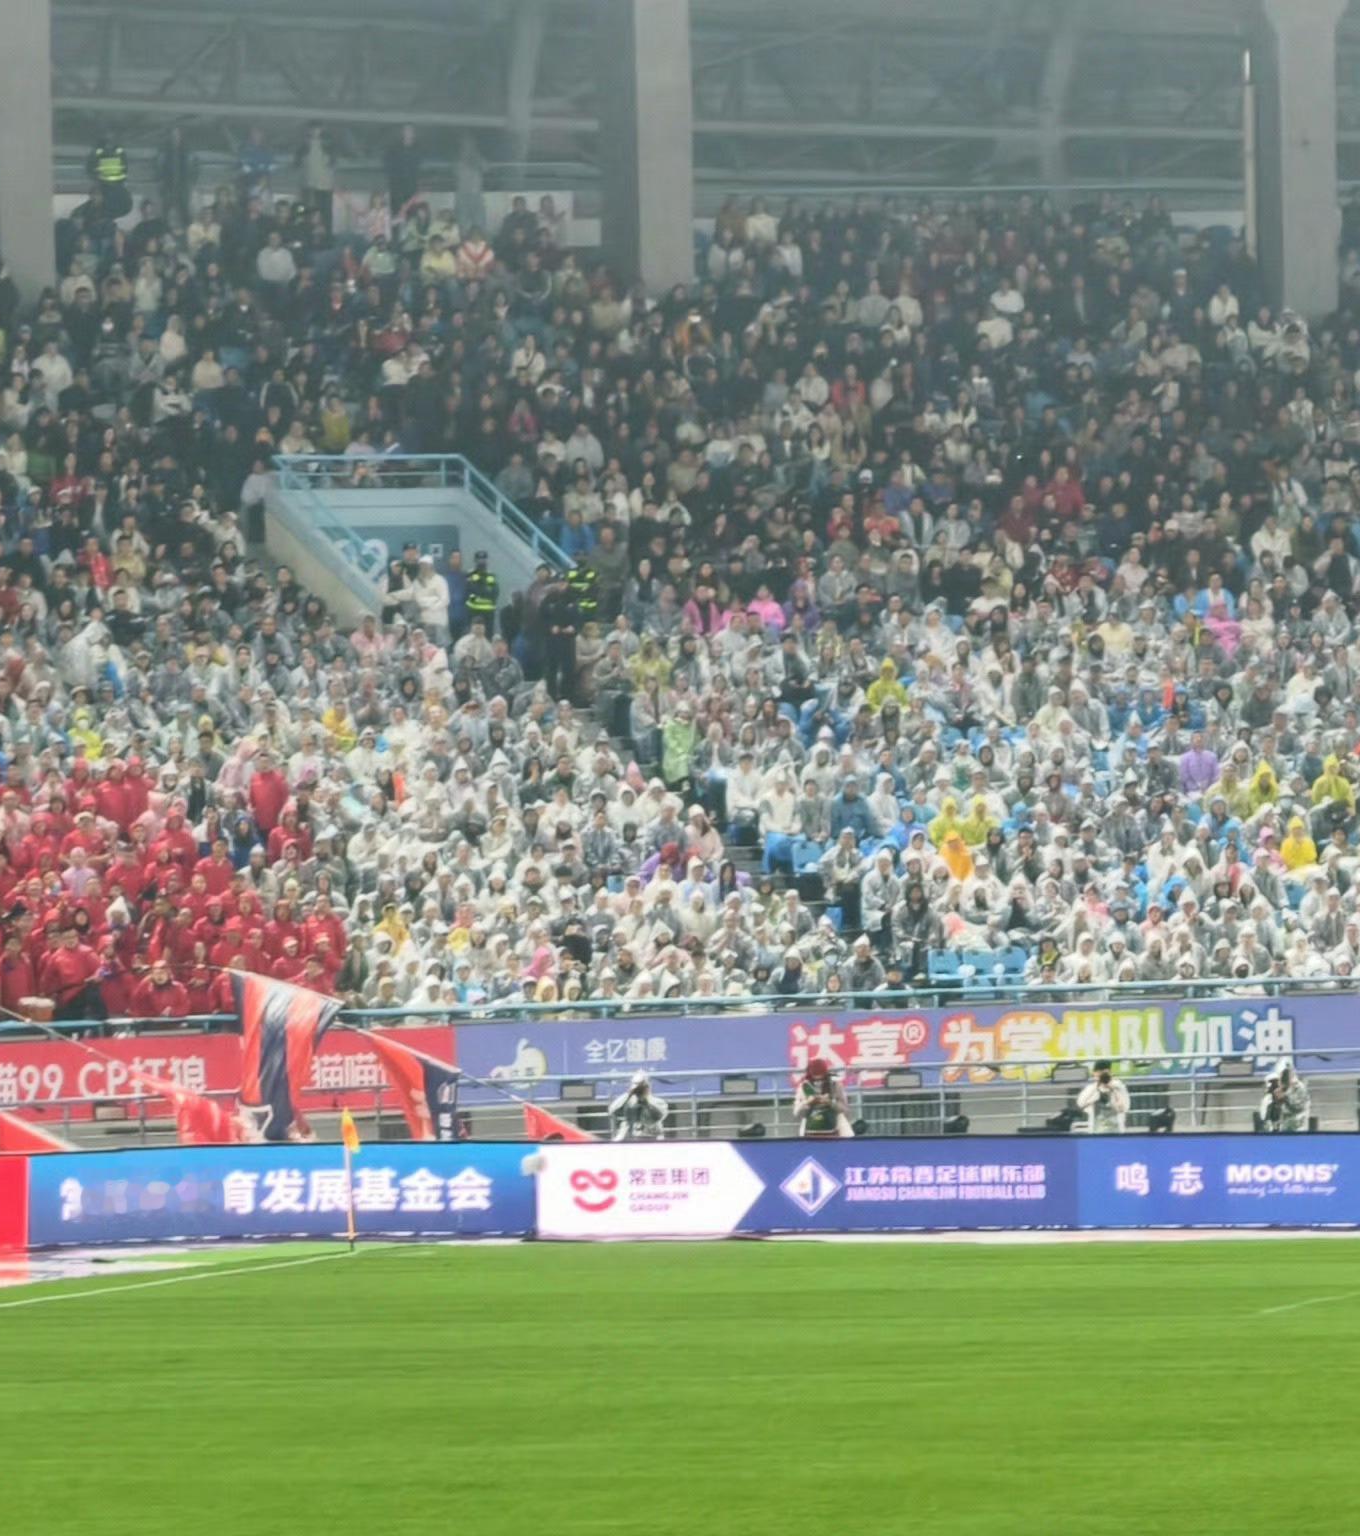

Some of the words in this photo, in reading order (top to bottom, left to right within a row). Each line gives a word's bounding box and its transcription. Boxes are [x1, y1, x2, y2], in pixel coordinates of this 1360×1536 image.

[943, 1007, 1295, 1083] 为常州队加油
[1115, 1162, 1205, 1196] 鸣志
